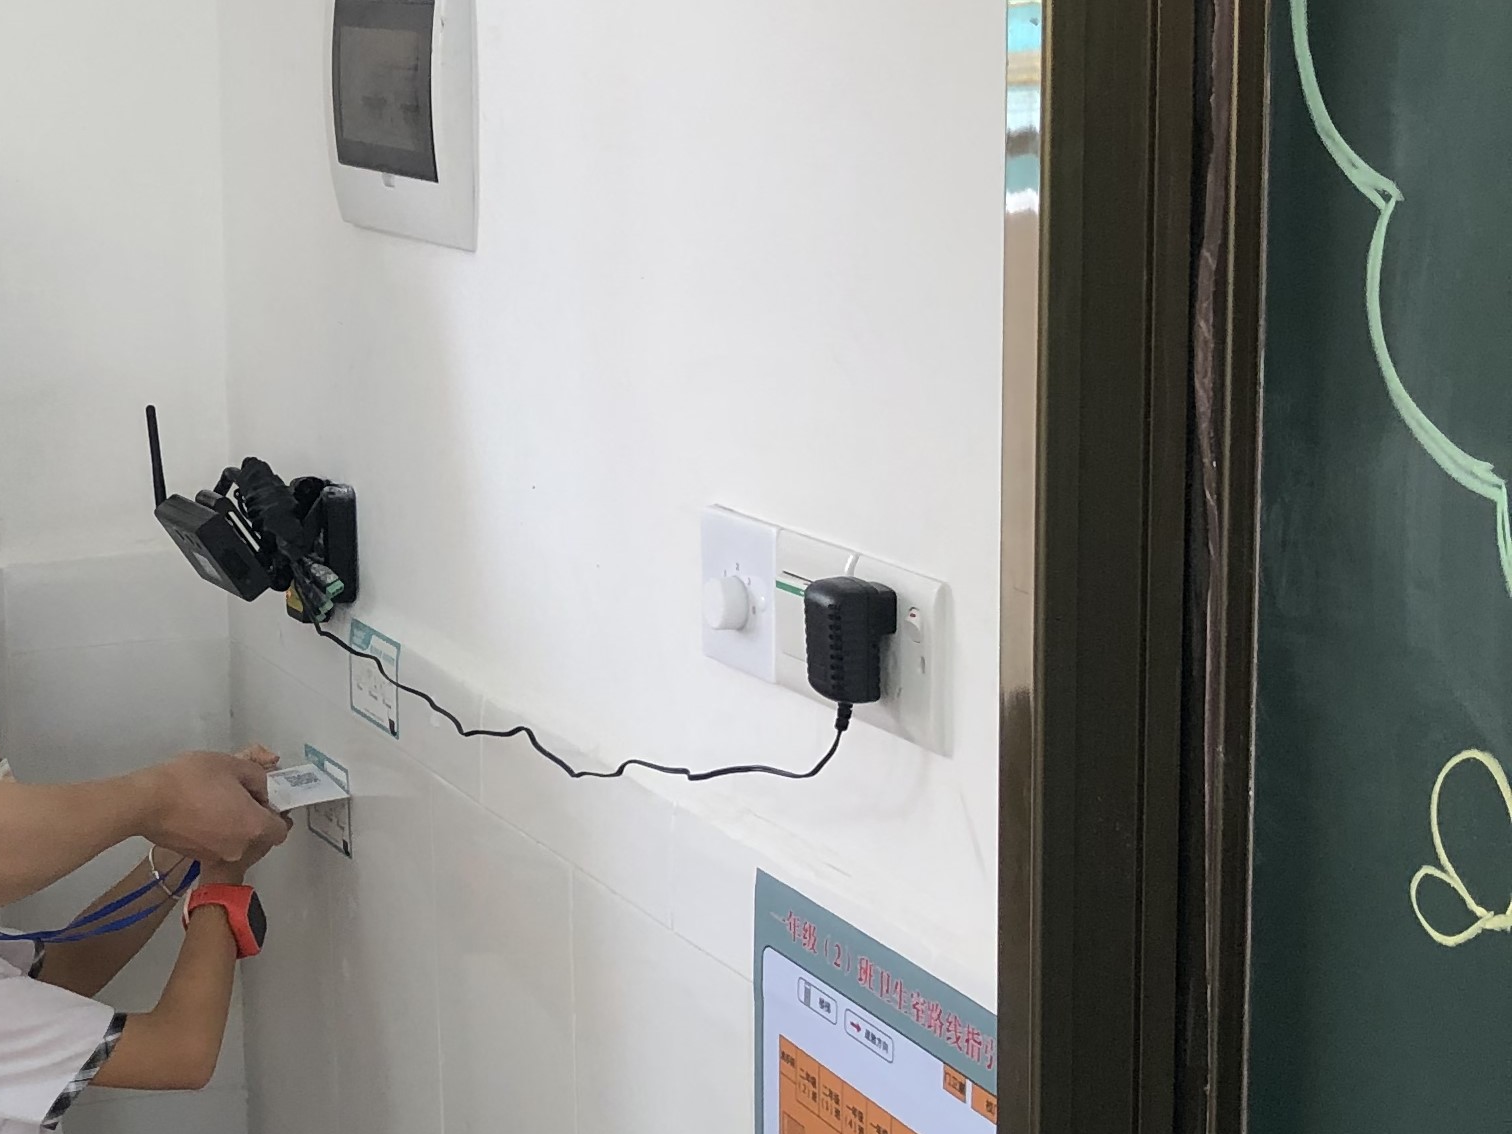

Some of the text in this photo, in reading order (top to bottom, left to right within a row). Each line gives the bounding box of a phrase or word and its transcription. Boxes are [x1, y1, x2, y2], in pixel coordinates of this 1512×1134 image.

[770, 911, 996, 1070] 一年级（2）班卫生室路线指引
